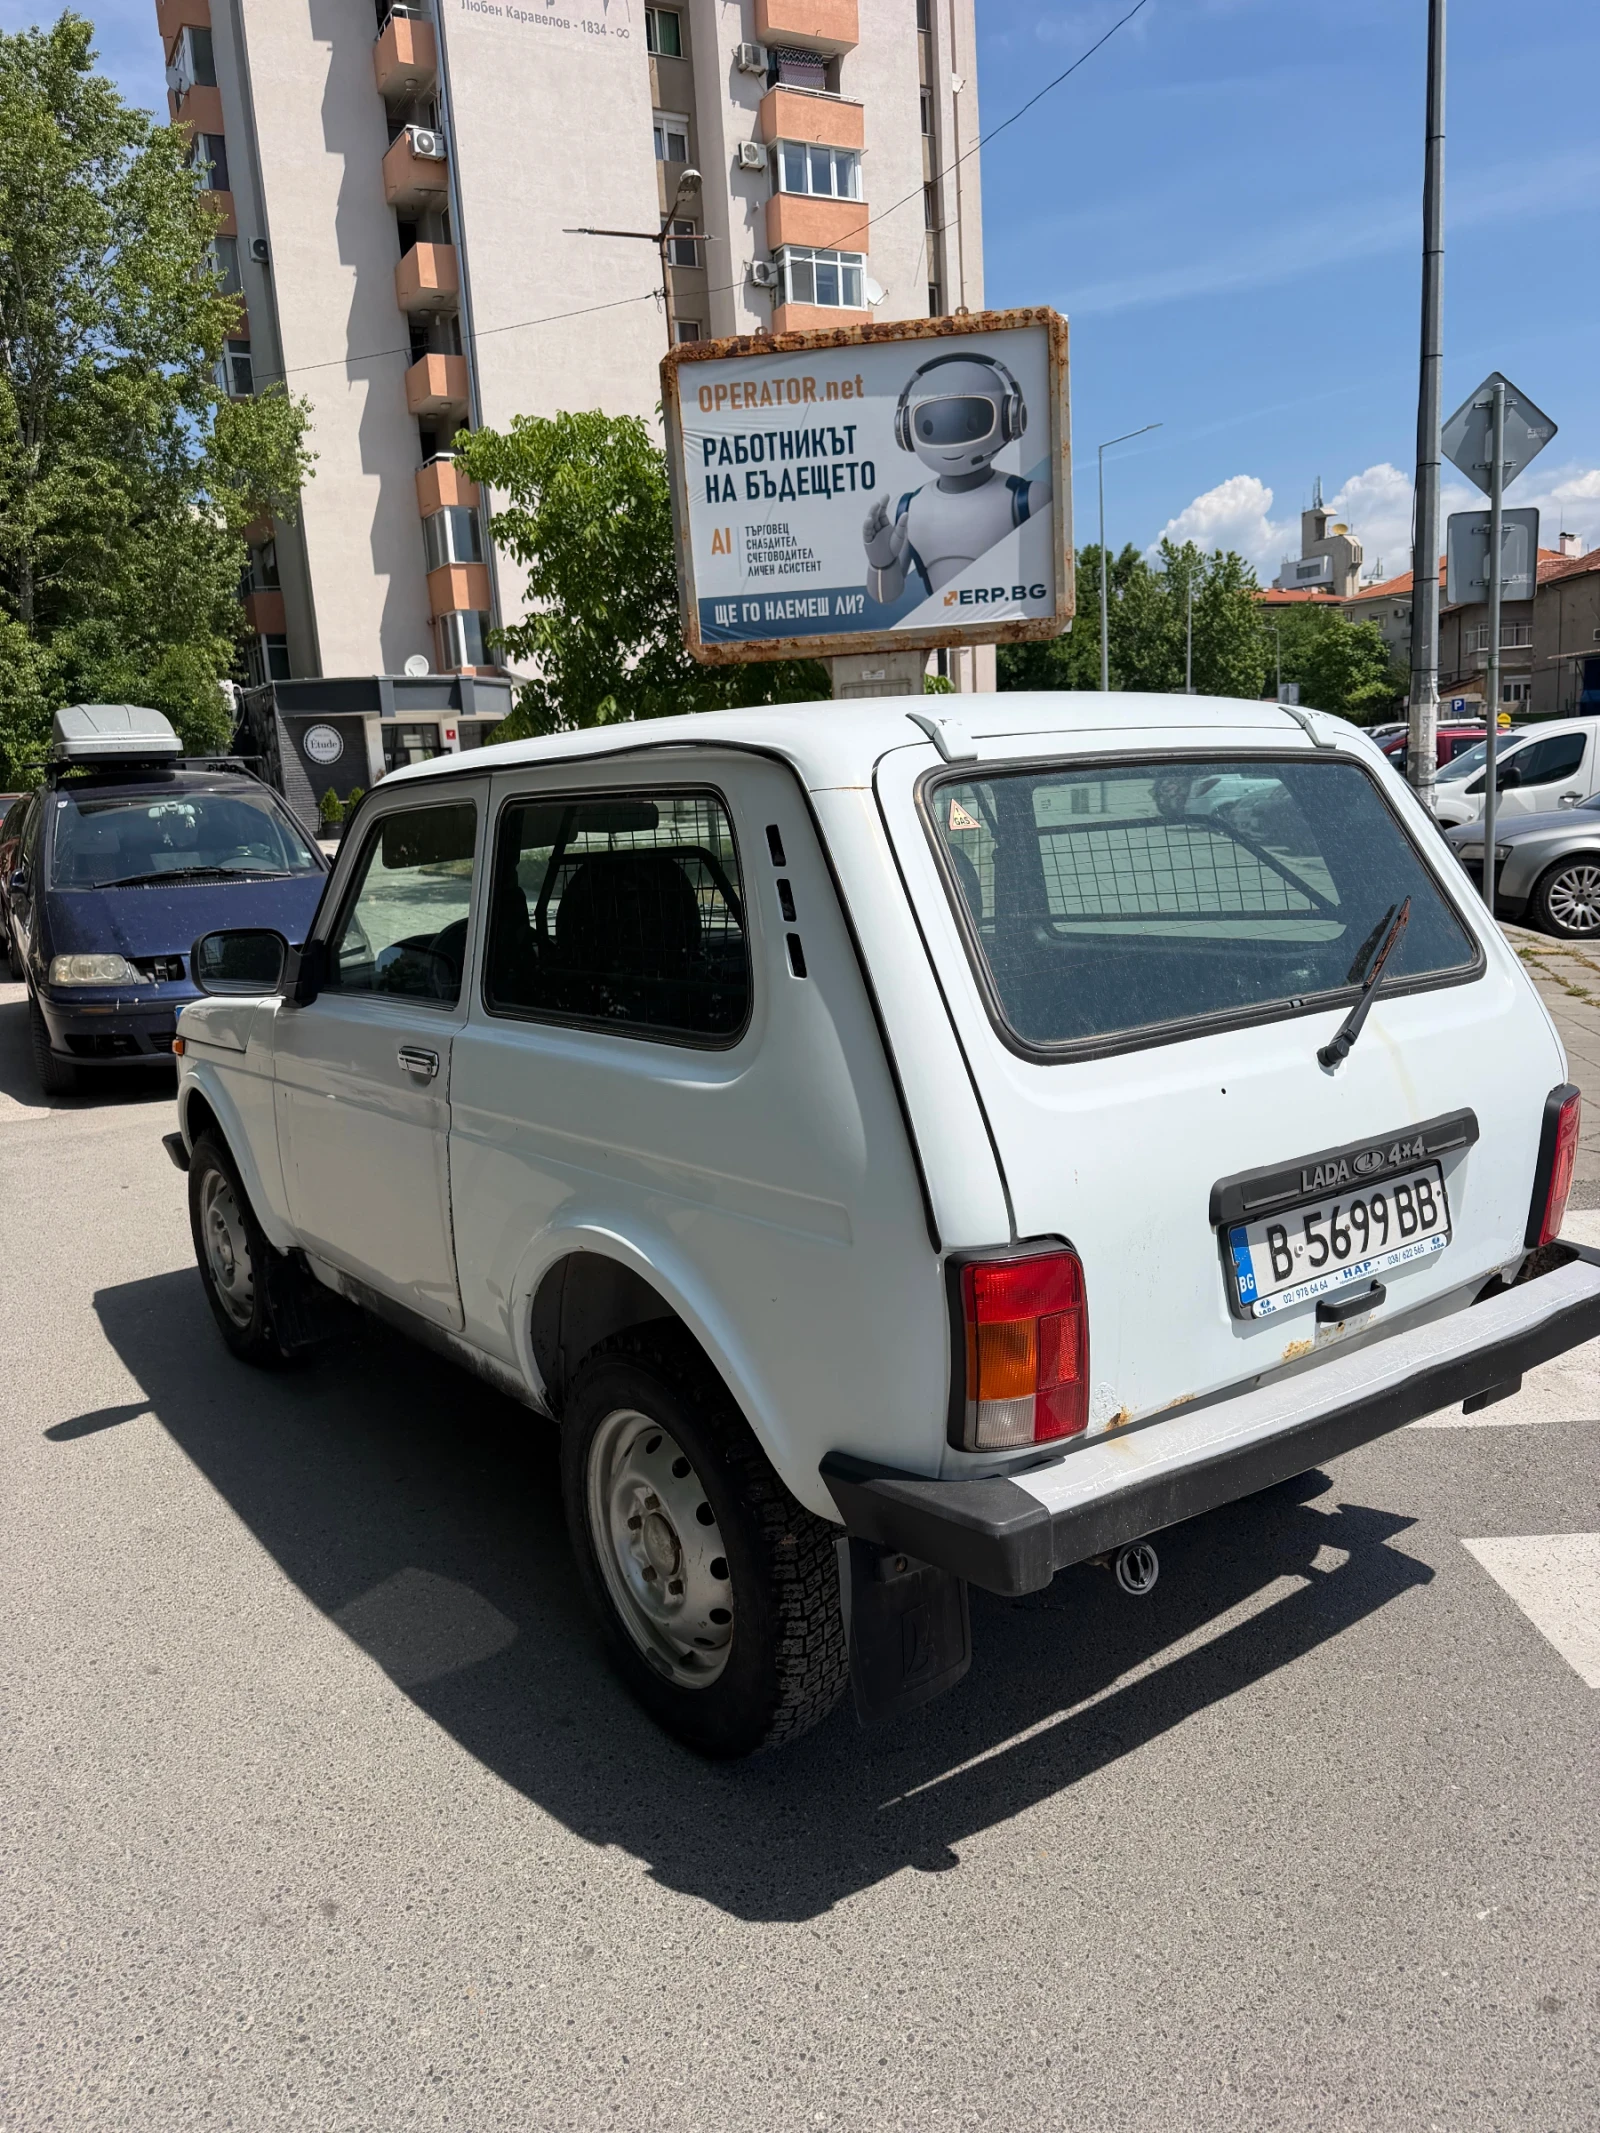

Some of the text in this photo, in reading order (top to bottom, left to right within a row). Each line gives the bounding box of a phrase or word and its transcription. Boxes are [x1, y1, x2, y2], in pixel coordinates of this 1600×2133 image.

[461, 0, 503, 16] Любен
[506, 5, 571, 29] Каравелов
[581, 20, 607, 36] 1834
[698, 374, 864, 412] OPERATOR.net
[702, 425, 857, 467] РАБОТНИКЪТ
[706, 461, 876, 504] НА БЪДЕЩЕТО
[711, 528, 731, 555] AI
[745, 523, 790, 537] ТЪРГОВЕЦ
[746, 536, 797, 550] СНАБДИТЕЛ
[747, 548, 814, 563] СЧЕТОВОДИТЕЛ
[748, 560, 822, 577] ЛИЧЕН АСИСТЕНТ
[960, 584, 1047, 605] ERP.BG
[715, 594, 864, 627] ЩЕ ГО НАЕМЕШ ЛИ?
[1454, 700, 1462, 710] P
[954, 817, 971, 825] GAS
[1302, 1136, 1425, 1192] LADA 4x4
[1267, 1178, 1438, 1283] B 5699 BB
[1430, 1242, 1444, 1251] LADA
[1238, 1272, 1254, 1293] BG
[1258, 1280, 1328, 1316] LADA 02/ 978 64 64
